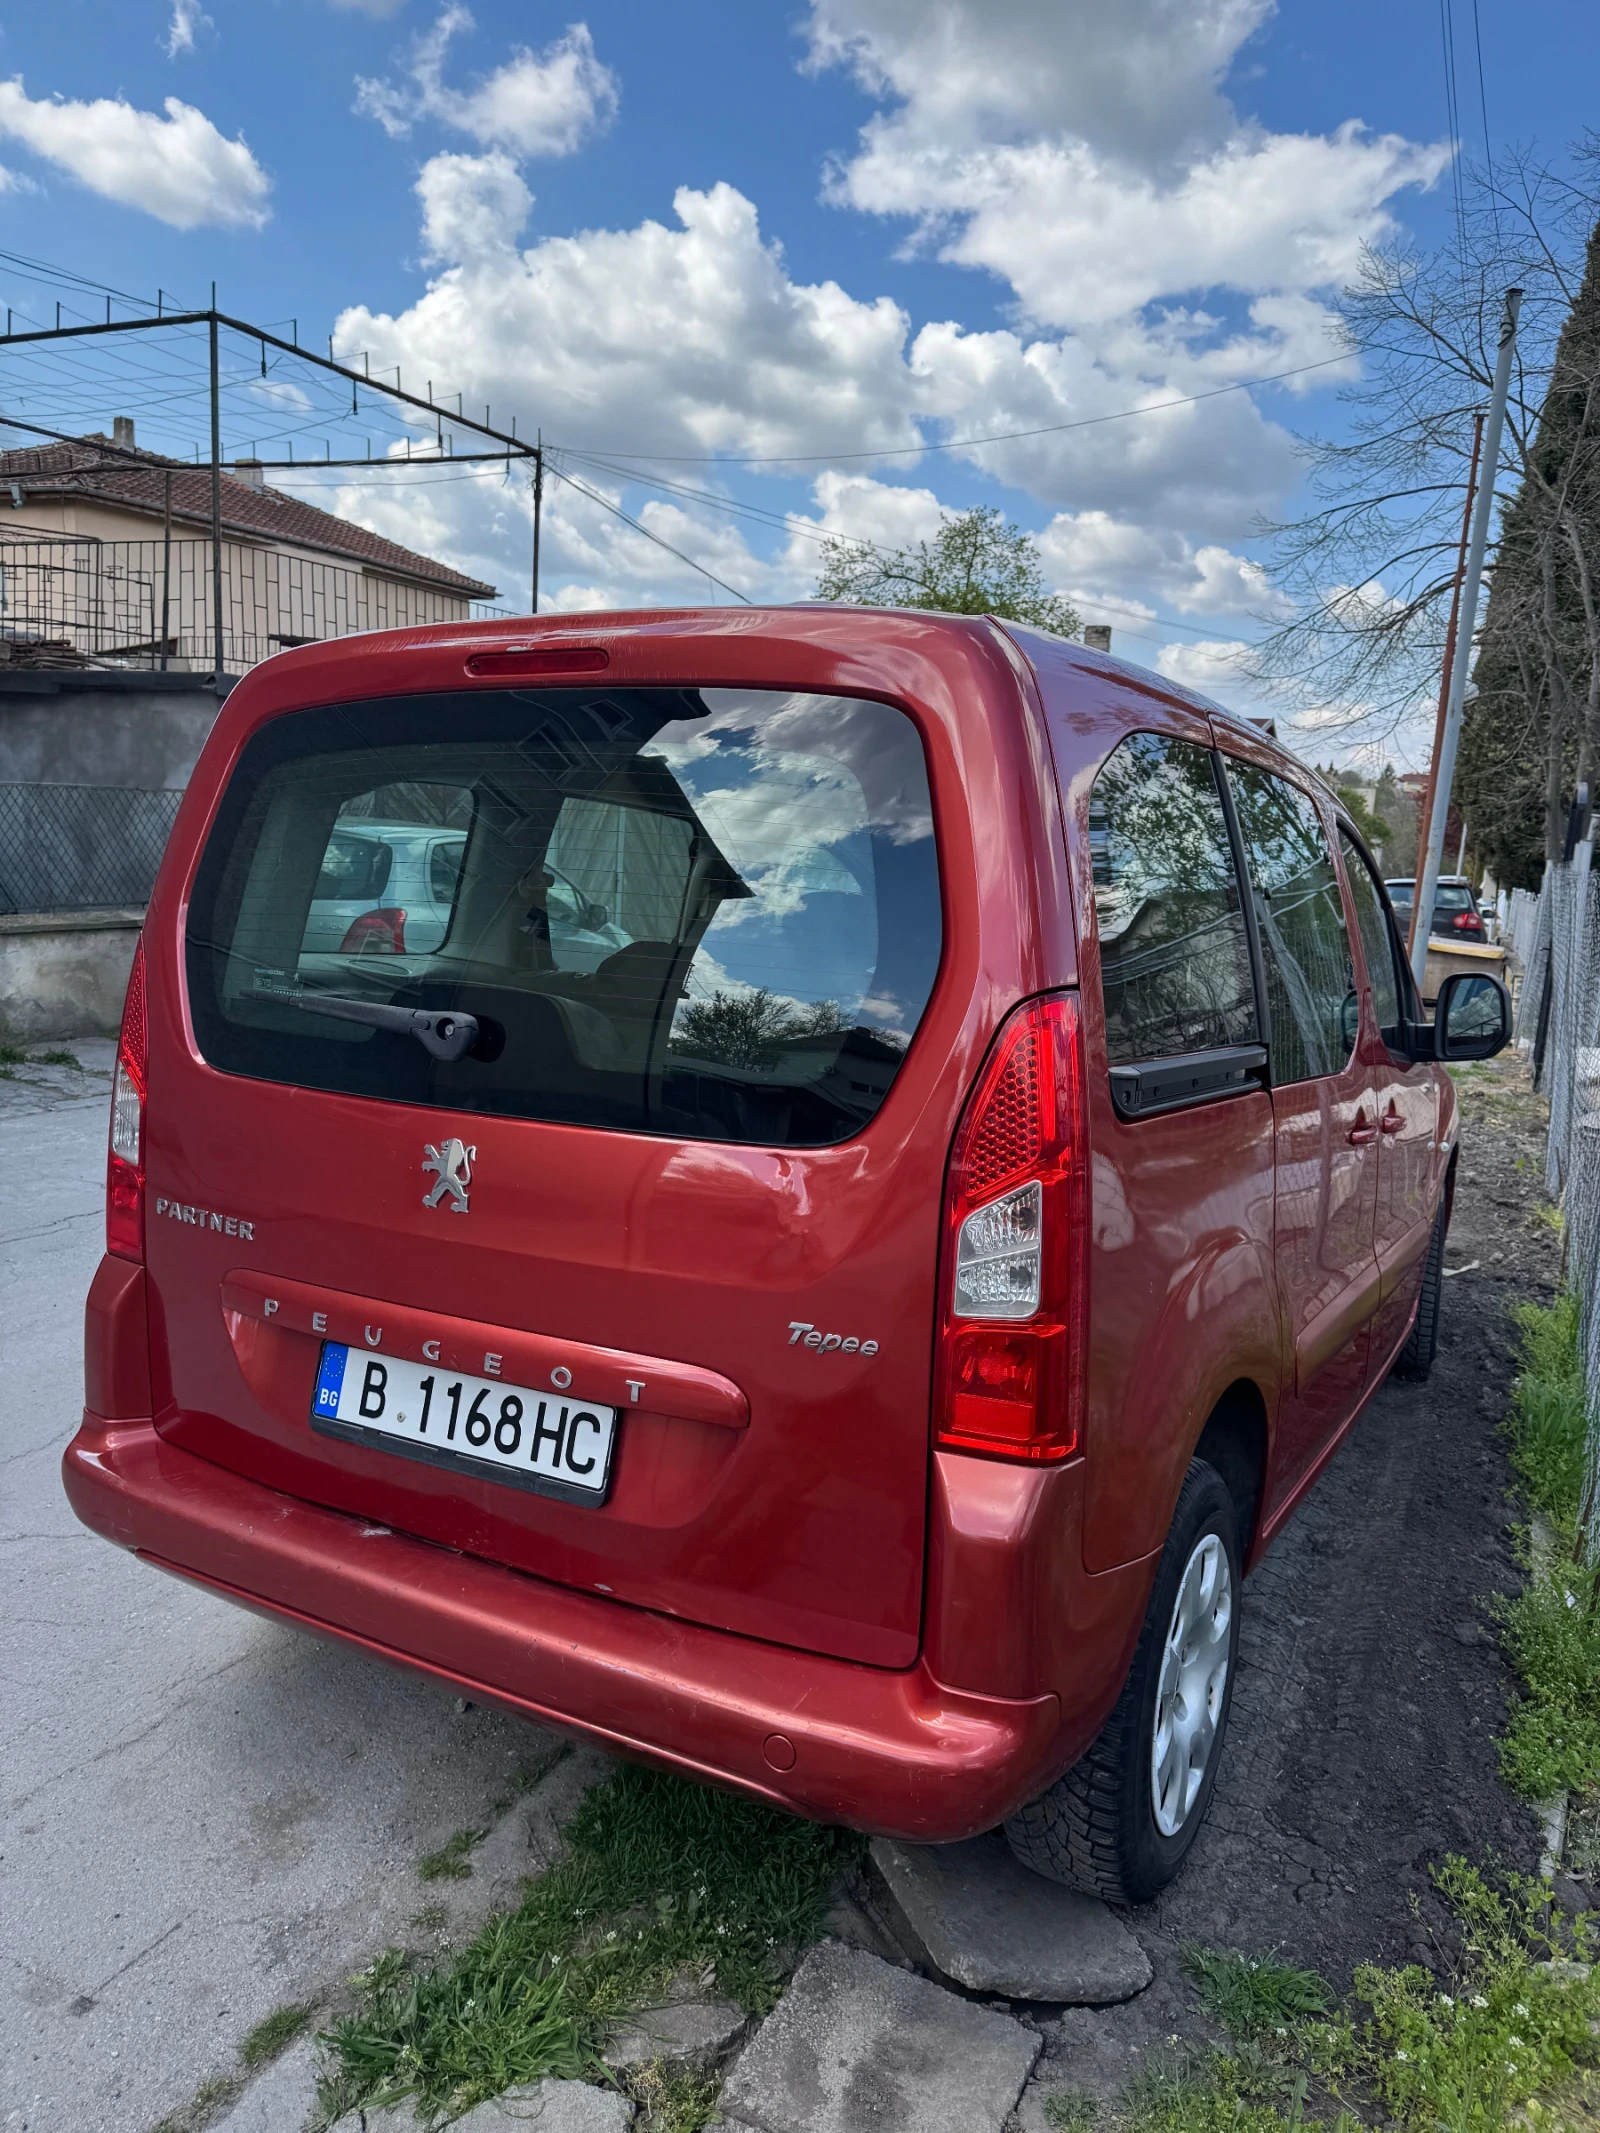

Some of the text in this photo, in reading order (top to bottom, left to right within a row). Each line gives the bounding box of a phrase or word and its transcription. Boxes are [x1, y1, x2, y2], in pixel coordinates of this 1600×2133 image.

[156, 1198, 255, 1240] PARTNER
[264, 1298, 646, 1402] PEUGEOT
[788, 1321, 879, 1356] Tepee
[319, 1388, 338, 1407] BG
